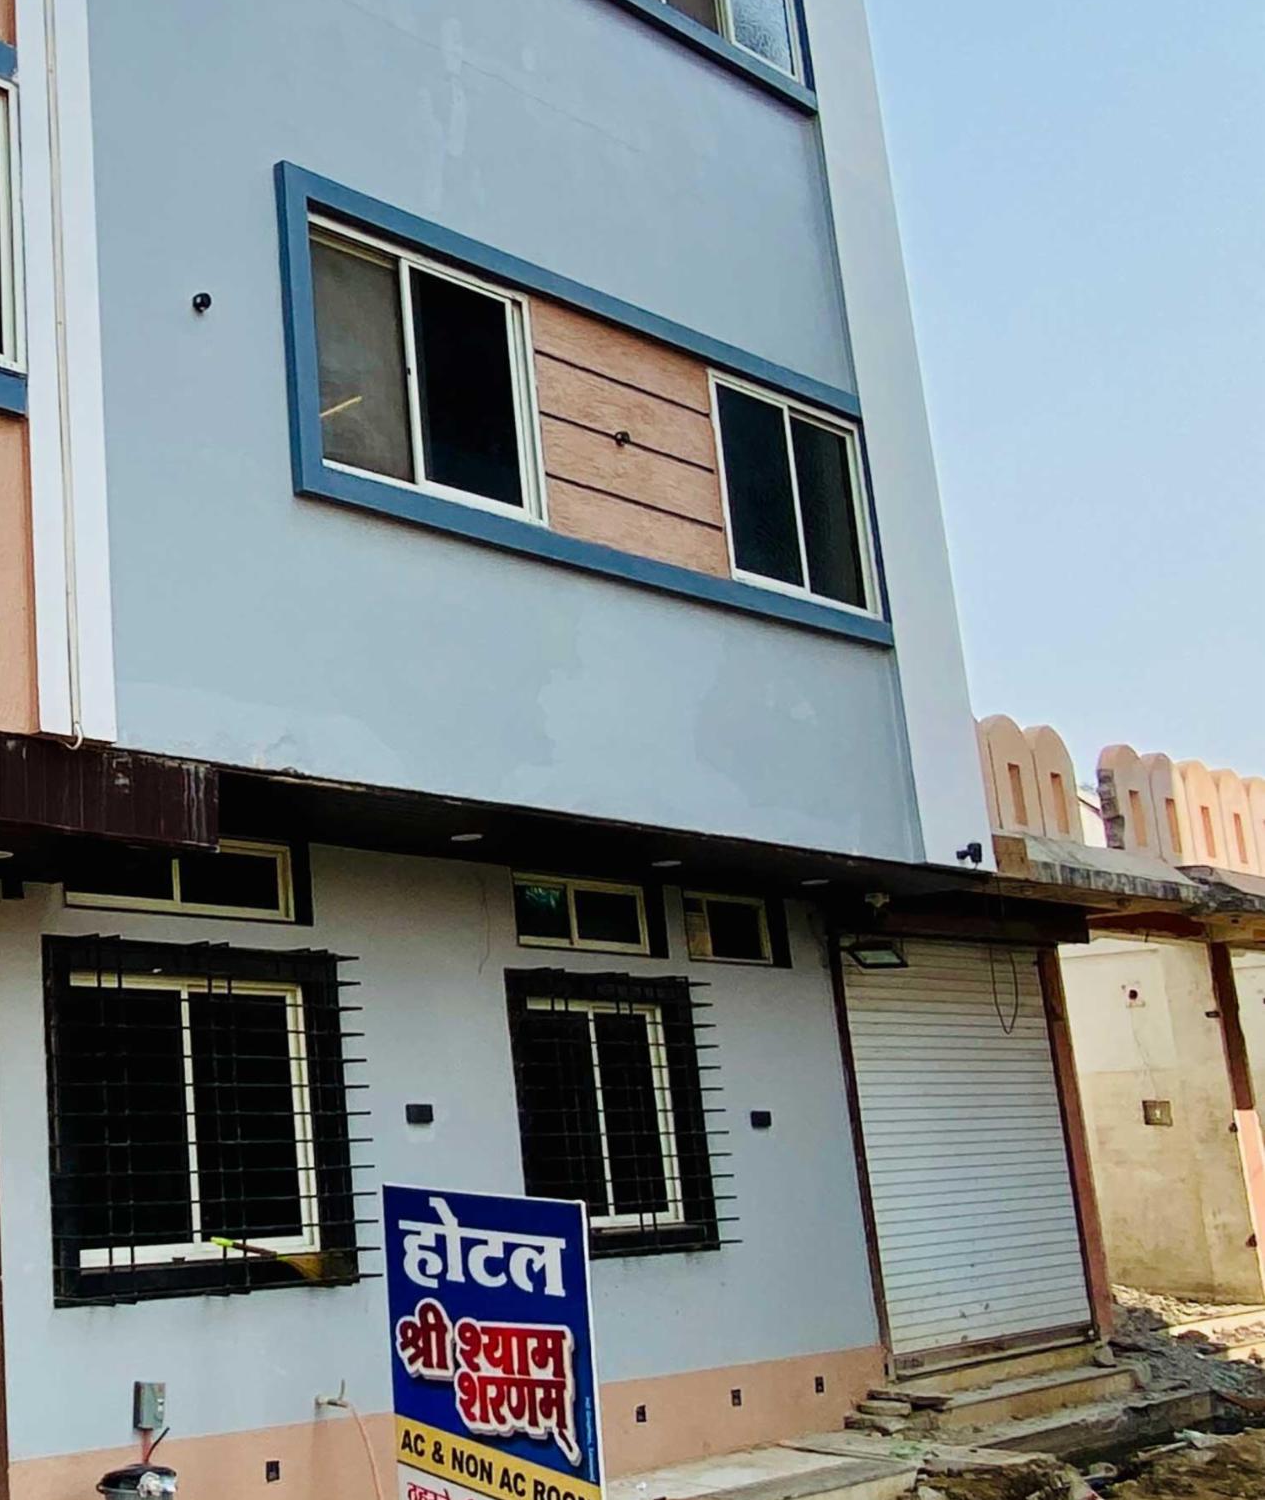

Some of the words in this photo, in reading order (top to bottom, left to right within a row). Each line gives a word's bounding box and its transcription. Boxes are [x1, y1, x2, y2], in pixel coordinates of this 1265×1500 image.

[398, 1197, 566, 1297] होटल
[398, 1300, 450, 1372] श्री
[456, 1321, 567, 1380] श्याम
[456, 1371, 574, 1454] शरणम्
[401, 1429, 426, 1457] AC
[431, 1440, 445, 1465] &
[451, 1447, 494, 1485] NON
[499, 1467, 527, 1497] AC
